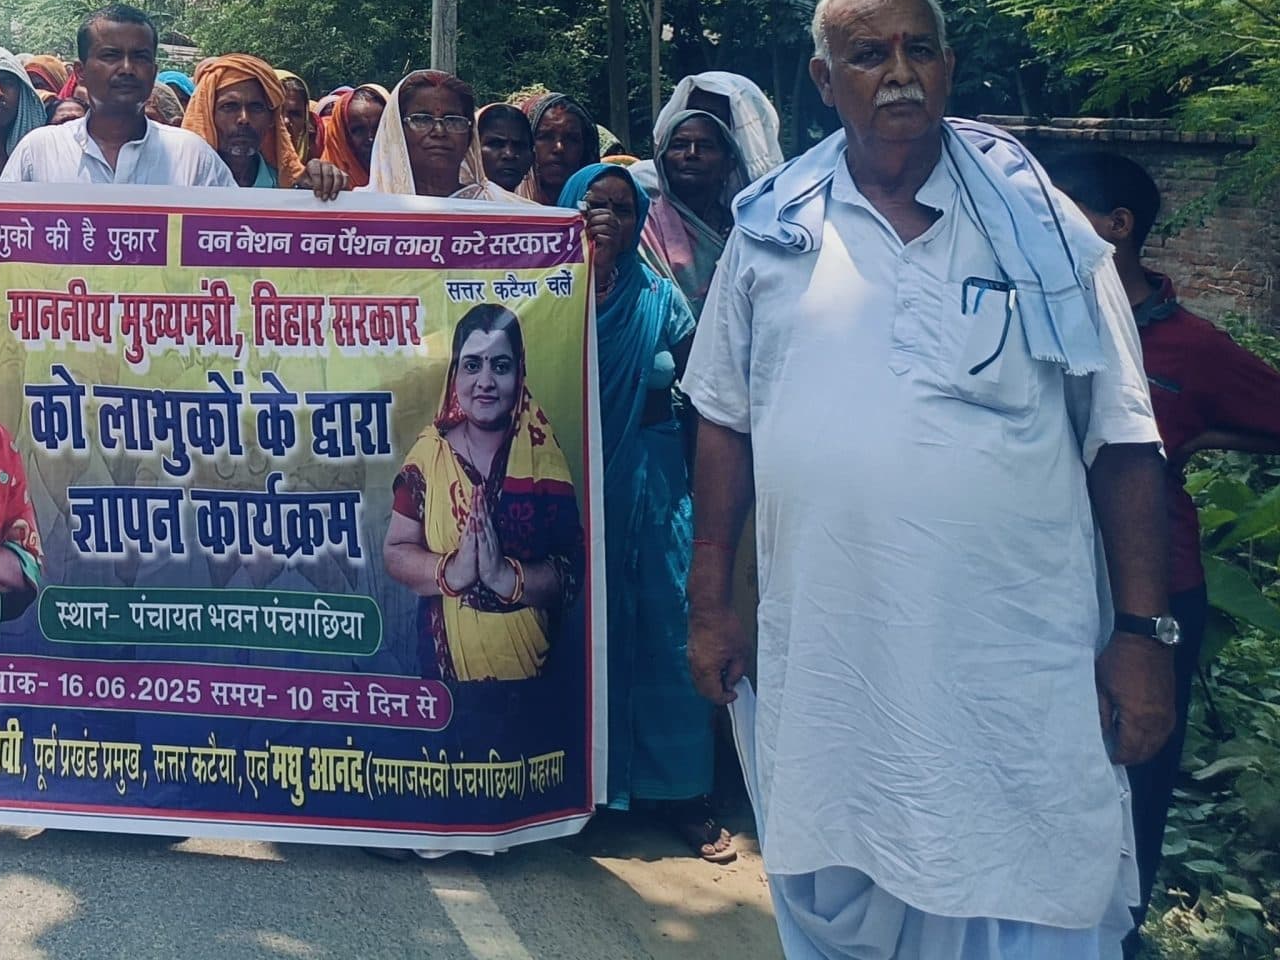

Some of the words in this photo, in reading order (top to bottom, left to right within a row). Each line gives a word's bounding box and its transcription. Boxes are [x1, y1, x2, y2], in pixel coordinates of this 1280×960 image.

[45, 218, 70, 251] की
[82, 218, 96, 252] है
[108, 227, 159, 260] पुकार
[198, 229, 232, 254] वन
[236, 225, 292, 254] नेशन
[300, 232, 335, 256] वन
[339, 228, 396, 256] पेंशन
[396, 234, 445, 263] लागू
[451, 230, 488, 255] करे
[446, 280, 485, 300] सत्तर
[493, 271, 537, 299] कटैया
[545, 270, 573, 296] चलें
[7, 279, 115, 343] माननीय
[251, 282, 325, 346] बिहार
[329, 295, 421, 346] सरकार
[24, 365, 86, 450] को
[93, 371, 245, 477] लाभुकों
[250, 372, 298, 457] के
[305, 392, 393, 458] द्वारा
[68, 487, 185, 554] ज्ञापन
[190, 472, 363, 560] कार्यक्रम
[129, 594, 203, 632] पंचायत
[208, 603, 259, 633] भवन
[261, 597, 365, 640] पंचगछिया
[58, 673, 201, 703] 16.06.2025
[287, 686, 313, 711] 10
[322, 681, 360, 713] बजे
[367, 683, 409, 718] दिन
[416, 687, 437, 720] से
[33, 723, 57, 790] पूर्व
[59, 728, 100, 778] प्रखंड
[151, 744, 188, 783] सत्तर
[244, 739, 270, 799] एवं
[270, 745, 305, 806] मधु
[309, 736, 364, 792] आनंद
[366, 746, 451, 800] (समाजसेवी
[528, 750, 565, 794] सहरसा
